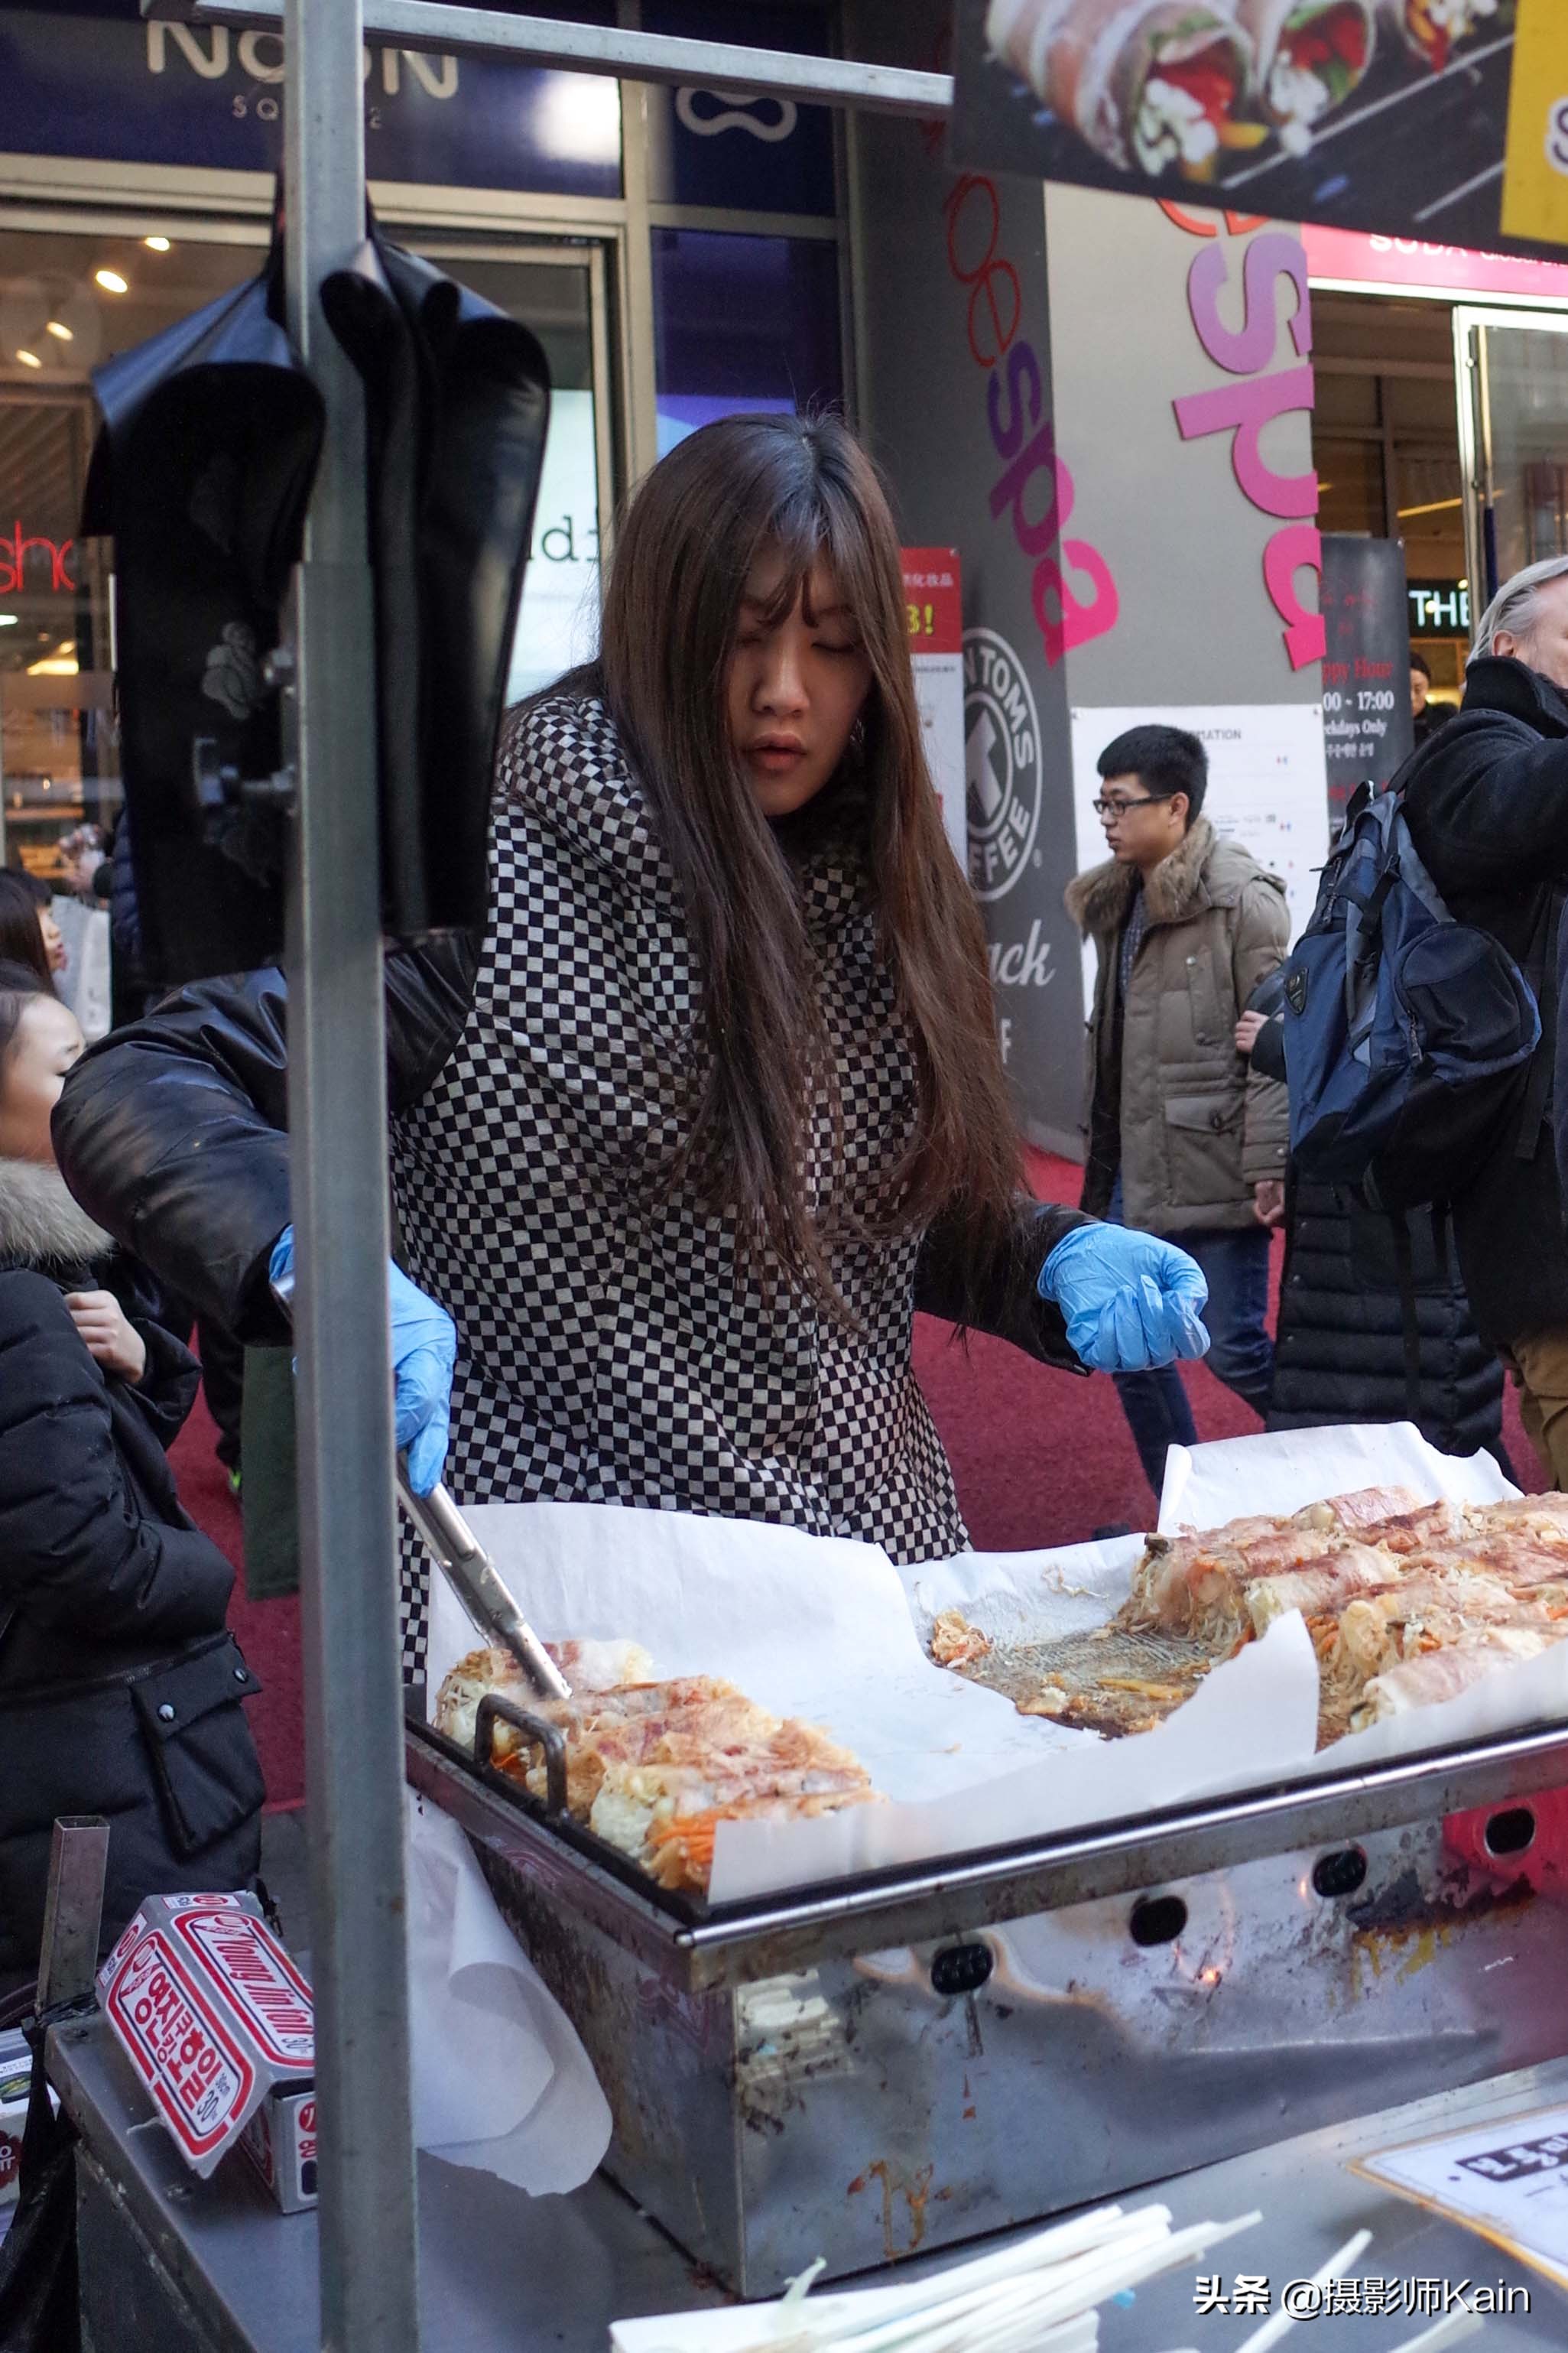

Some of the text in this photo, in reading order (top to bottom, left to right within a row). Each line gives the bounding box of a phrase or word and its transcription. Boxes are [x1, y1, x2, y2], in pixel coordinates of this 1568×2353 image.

[148, 19, 459, 99] NON
[979, 646, 1034, 770] TOMS
[1357, 690, 1394, 711] 17:00
[1362, 719, 1388, 738] Only
[211, 1937, 276, 1982] Young
